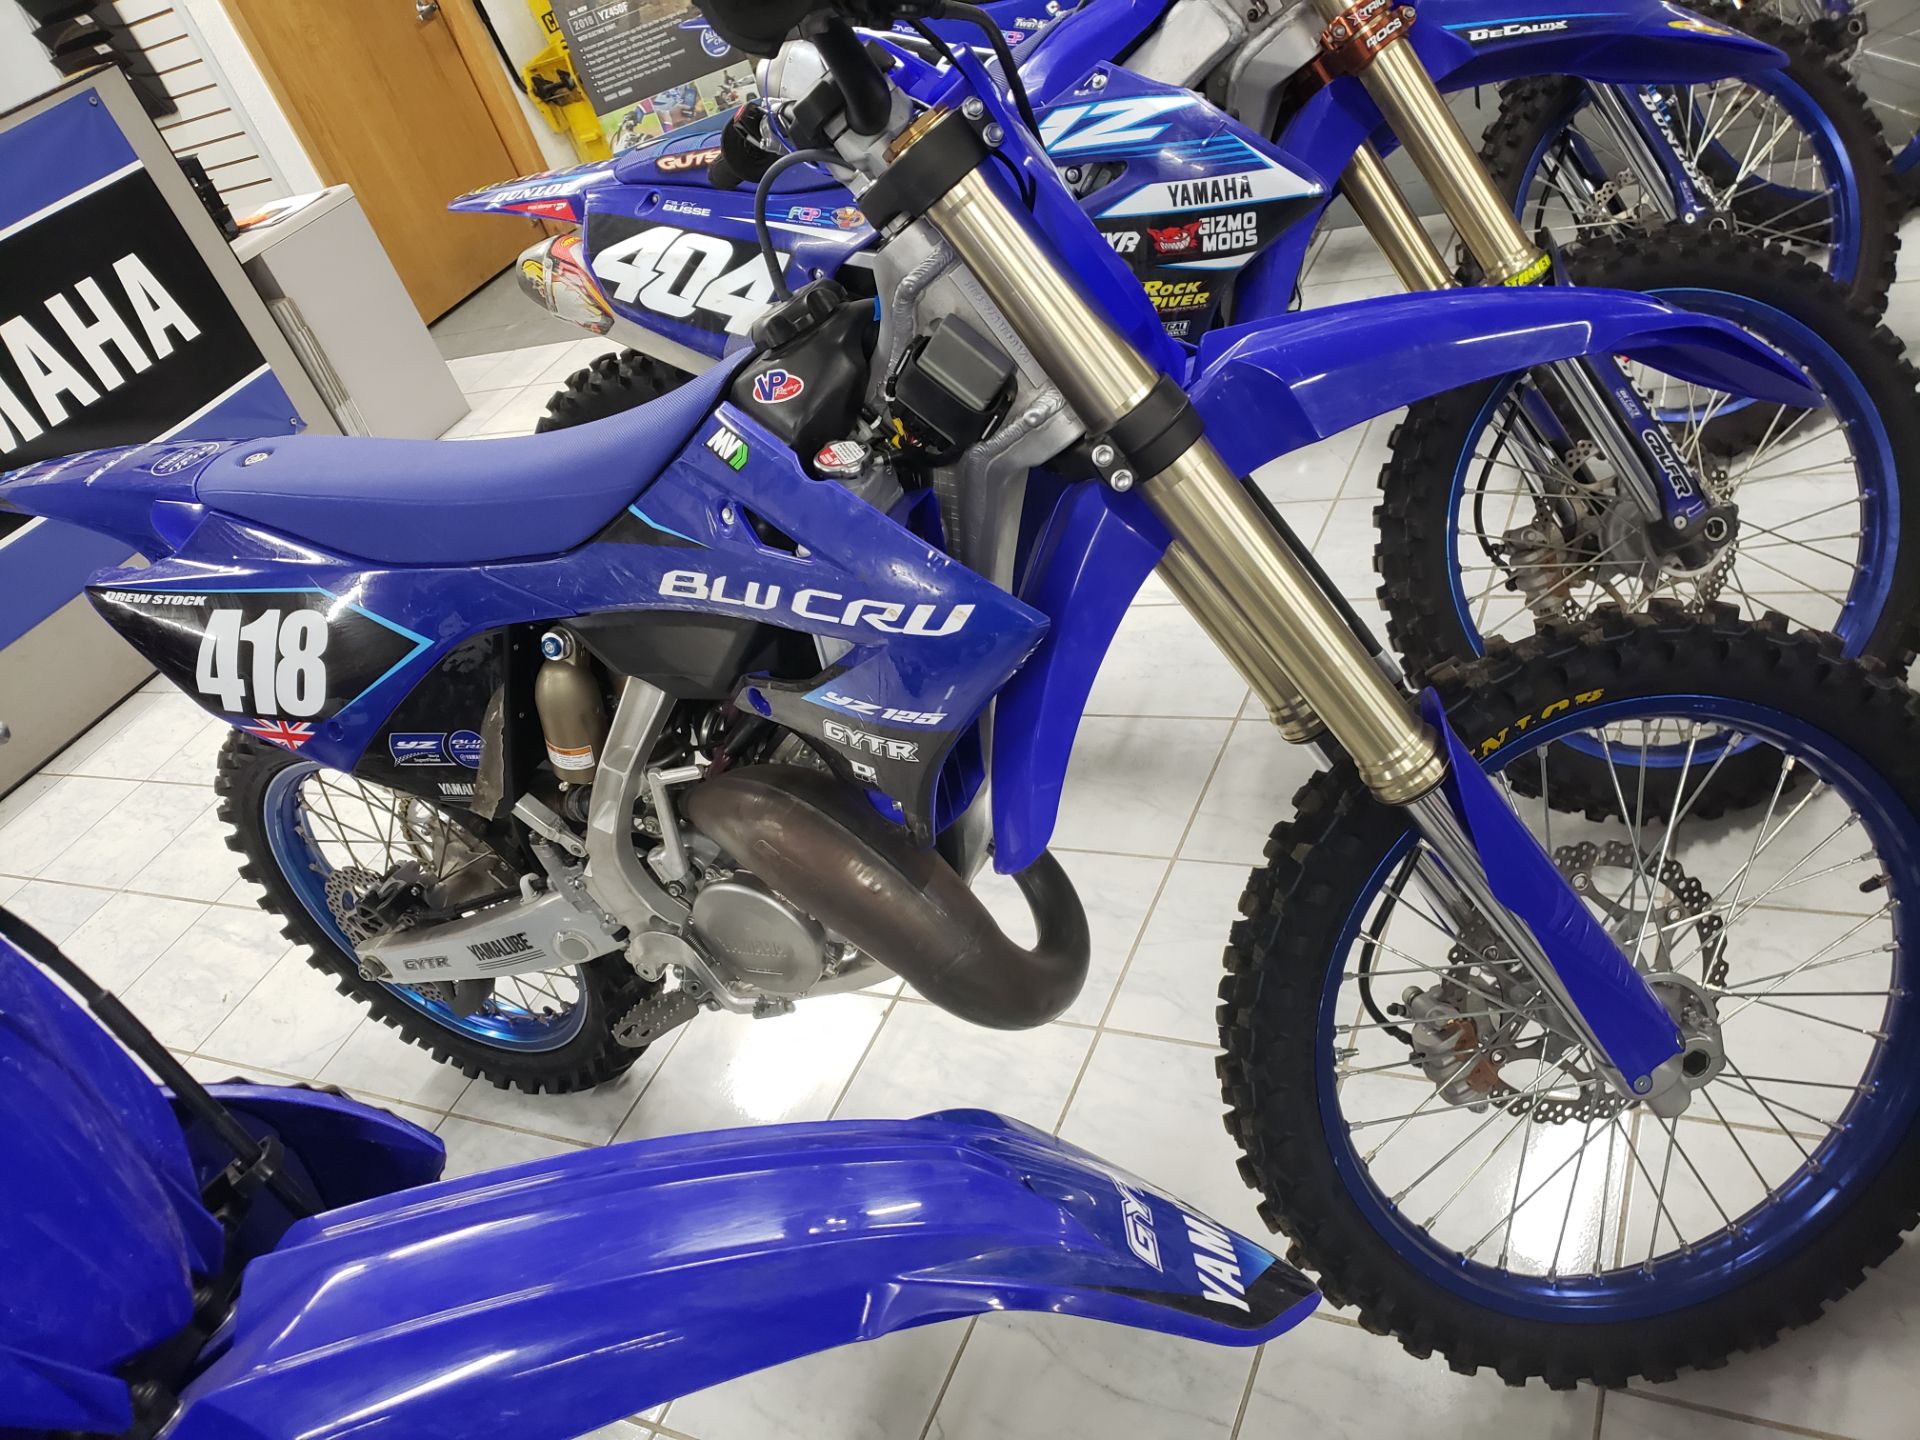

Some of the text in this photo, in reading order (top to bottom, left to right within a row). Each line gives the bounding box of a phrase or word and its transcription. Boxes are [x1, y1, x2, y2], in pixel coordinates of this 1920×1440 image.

[572, 15, 595, 31] 2018
[597, 1, 629, 21] YZ450F
[1000, 30, 1025, 44] CP
[656, 148, 721, 171] GUTS
[494, 182, 579, 201] DUNLOP
[1167, 175, 1254, 207] YAMAHA
[662, 205, 712, 217] BUSSE
[1198, 211, 1257, 235] GIZMO
[1202, 228, 1259, 252] MODS
[591, 225, 790, 336] 404
[755, 369, 788, 401] VP
[1642, 429, 1693, 499] GALFER
[104, 590, 208, 607] DREW STOCK
[658, 569, 976, 636] BLU CRU
[196, 608, 329, 717] 418
[820, 690, 949, 726] YZ 125
[822, 718, 920, 763] GYTR
[466, 931, 535, 961] YAMALUBE
[403, 954, 451, 972] GYTR
